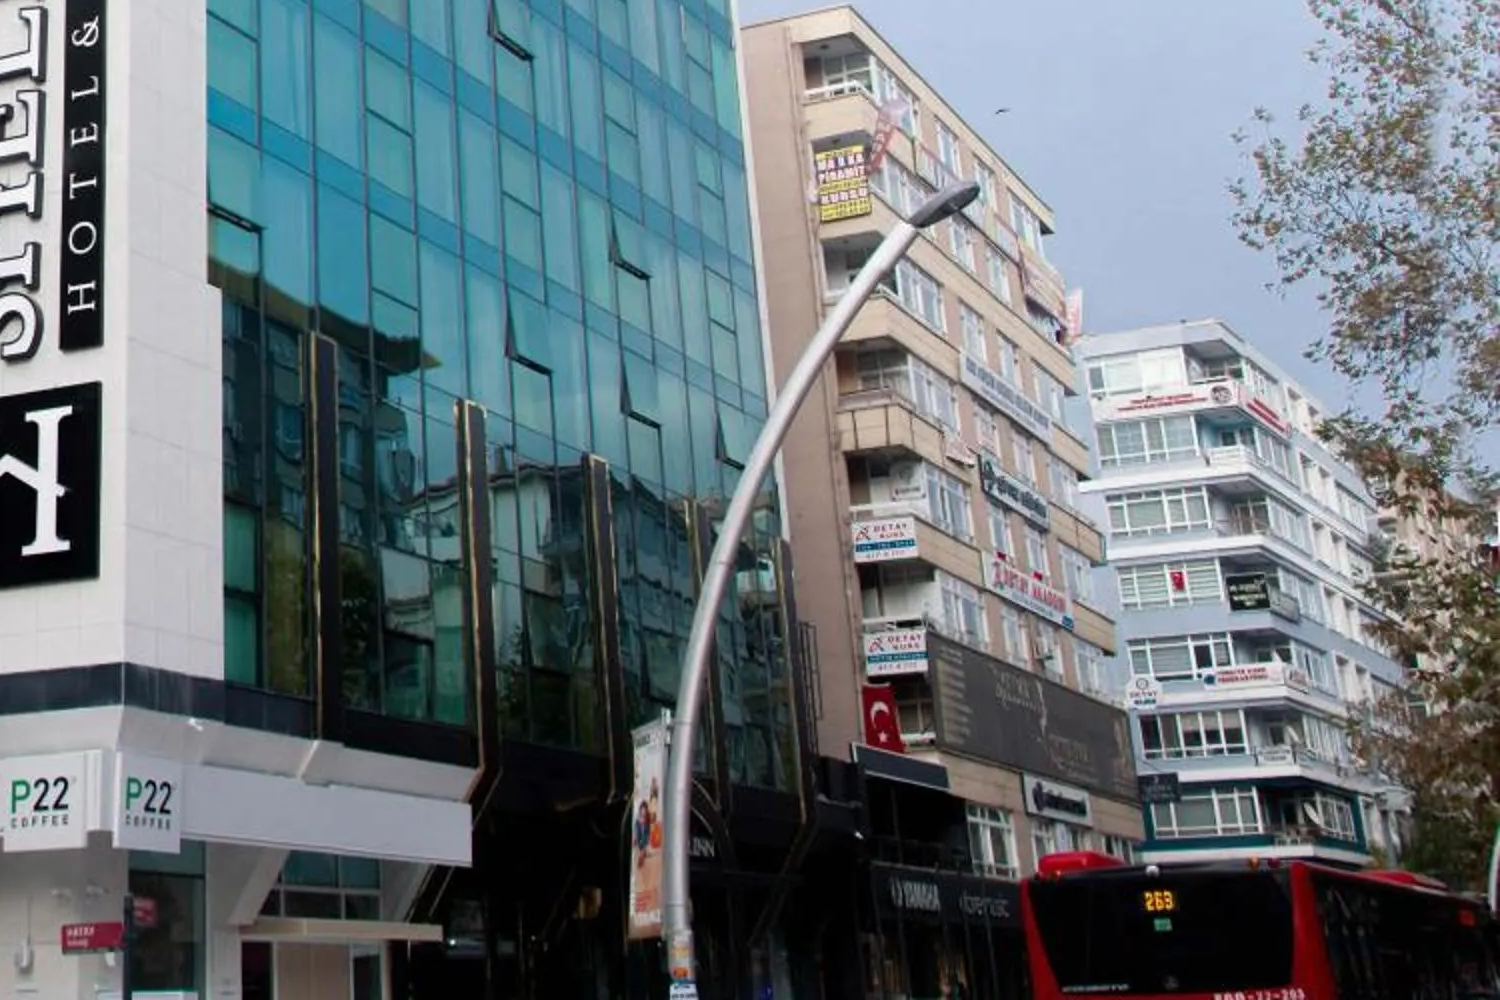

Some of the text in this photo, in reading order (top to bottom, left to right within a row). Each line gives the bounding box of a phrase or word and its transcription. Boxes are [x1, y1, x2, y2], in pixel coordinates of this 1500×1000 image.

[71, 15, 100, 47] &
[67, 74, 100, 314] HOTEL
[11, 777, 69, 814] P22
[125, 777, 172, 815] P22
[10, 814, 69, 829] COFFEE
[125, 814, 172, 831] COFFEE
